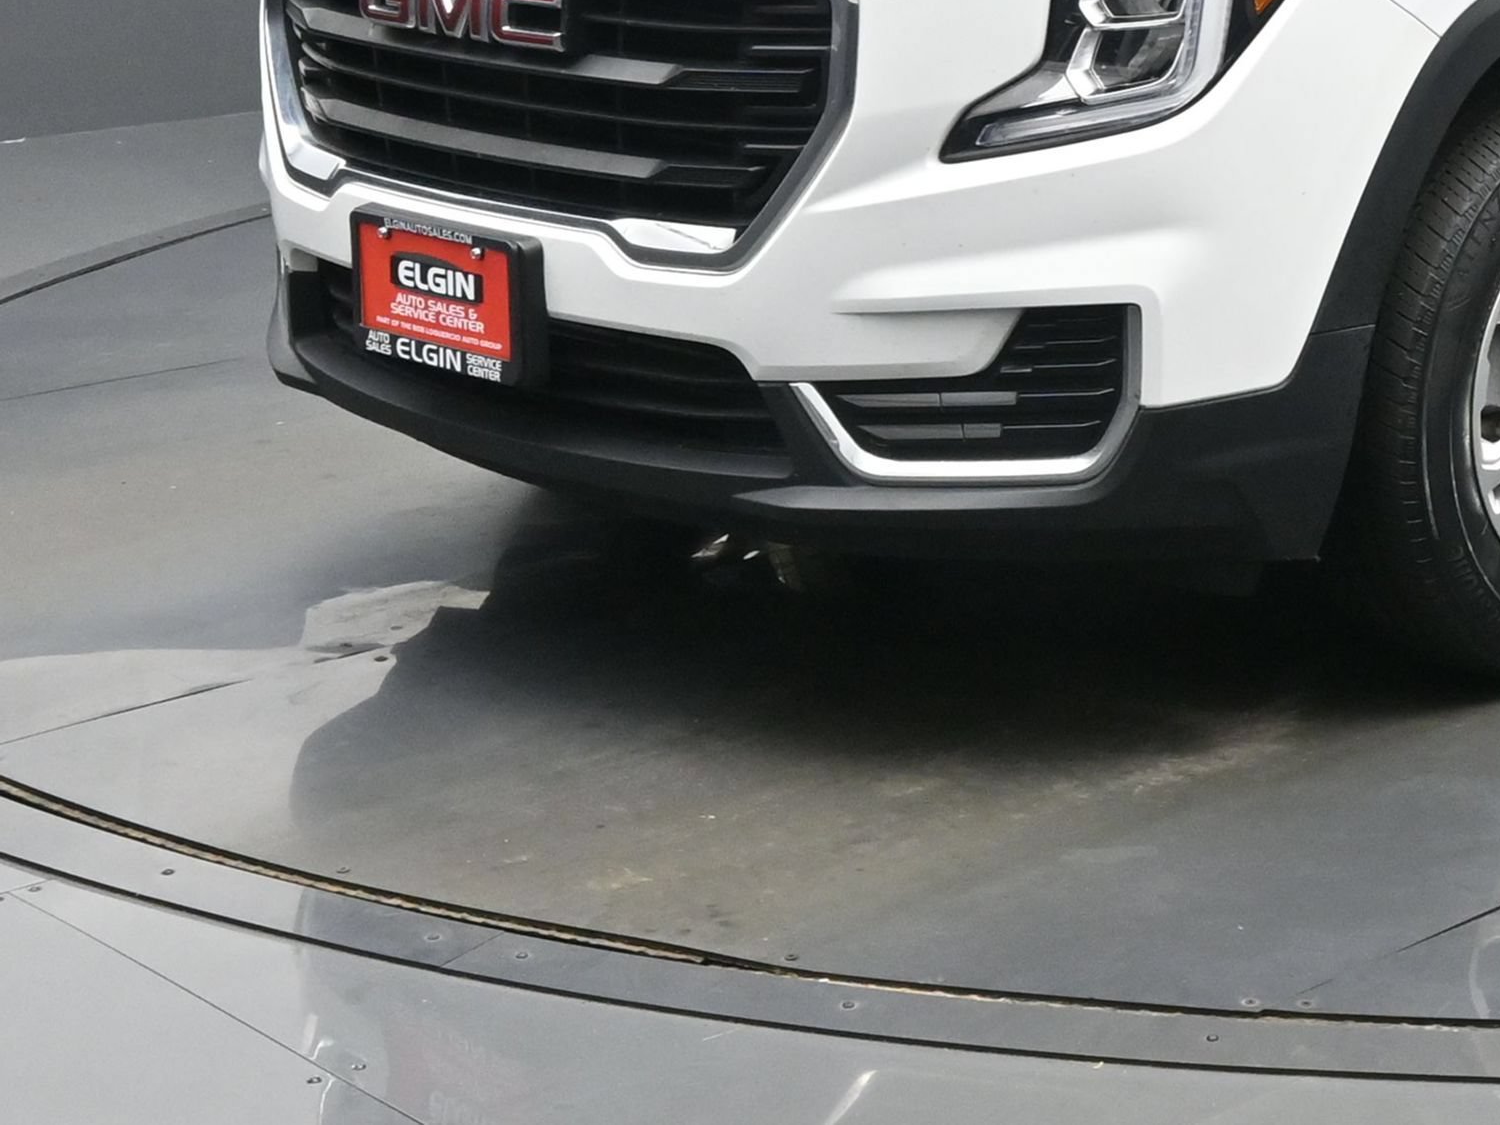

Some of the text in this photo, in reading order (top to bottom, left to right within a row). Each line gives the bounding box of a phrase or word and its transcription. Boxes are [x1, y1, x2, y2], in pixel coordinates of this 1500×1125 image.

[384, 217, 473, 245] ELGINAUTOSALES.COM
[398, 260, 475, 300] ELGIN
[390, 303, 484, 334] SERVICE CENTER
[396, 293, 478, 320] AUTO SALES &
[365, 340, 392, 356] SALES
[367, 330, 390, 344] AUTO
[396, 338, 462, 373] ELGIN
[466, 353, 502, 371] SERVICE
[467, 365, 501, 383] CENTER
